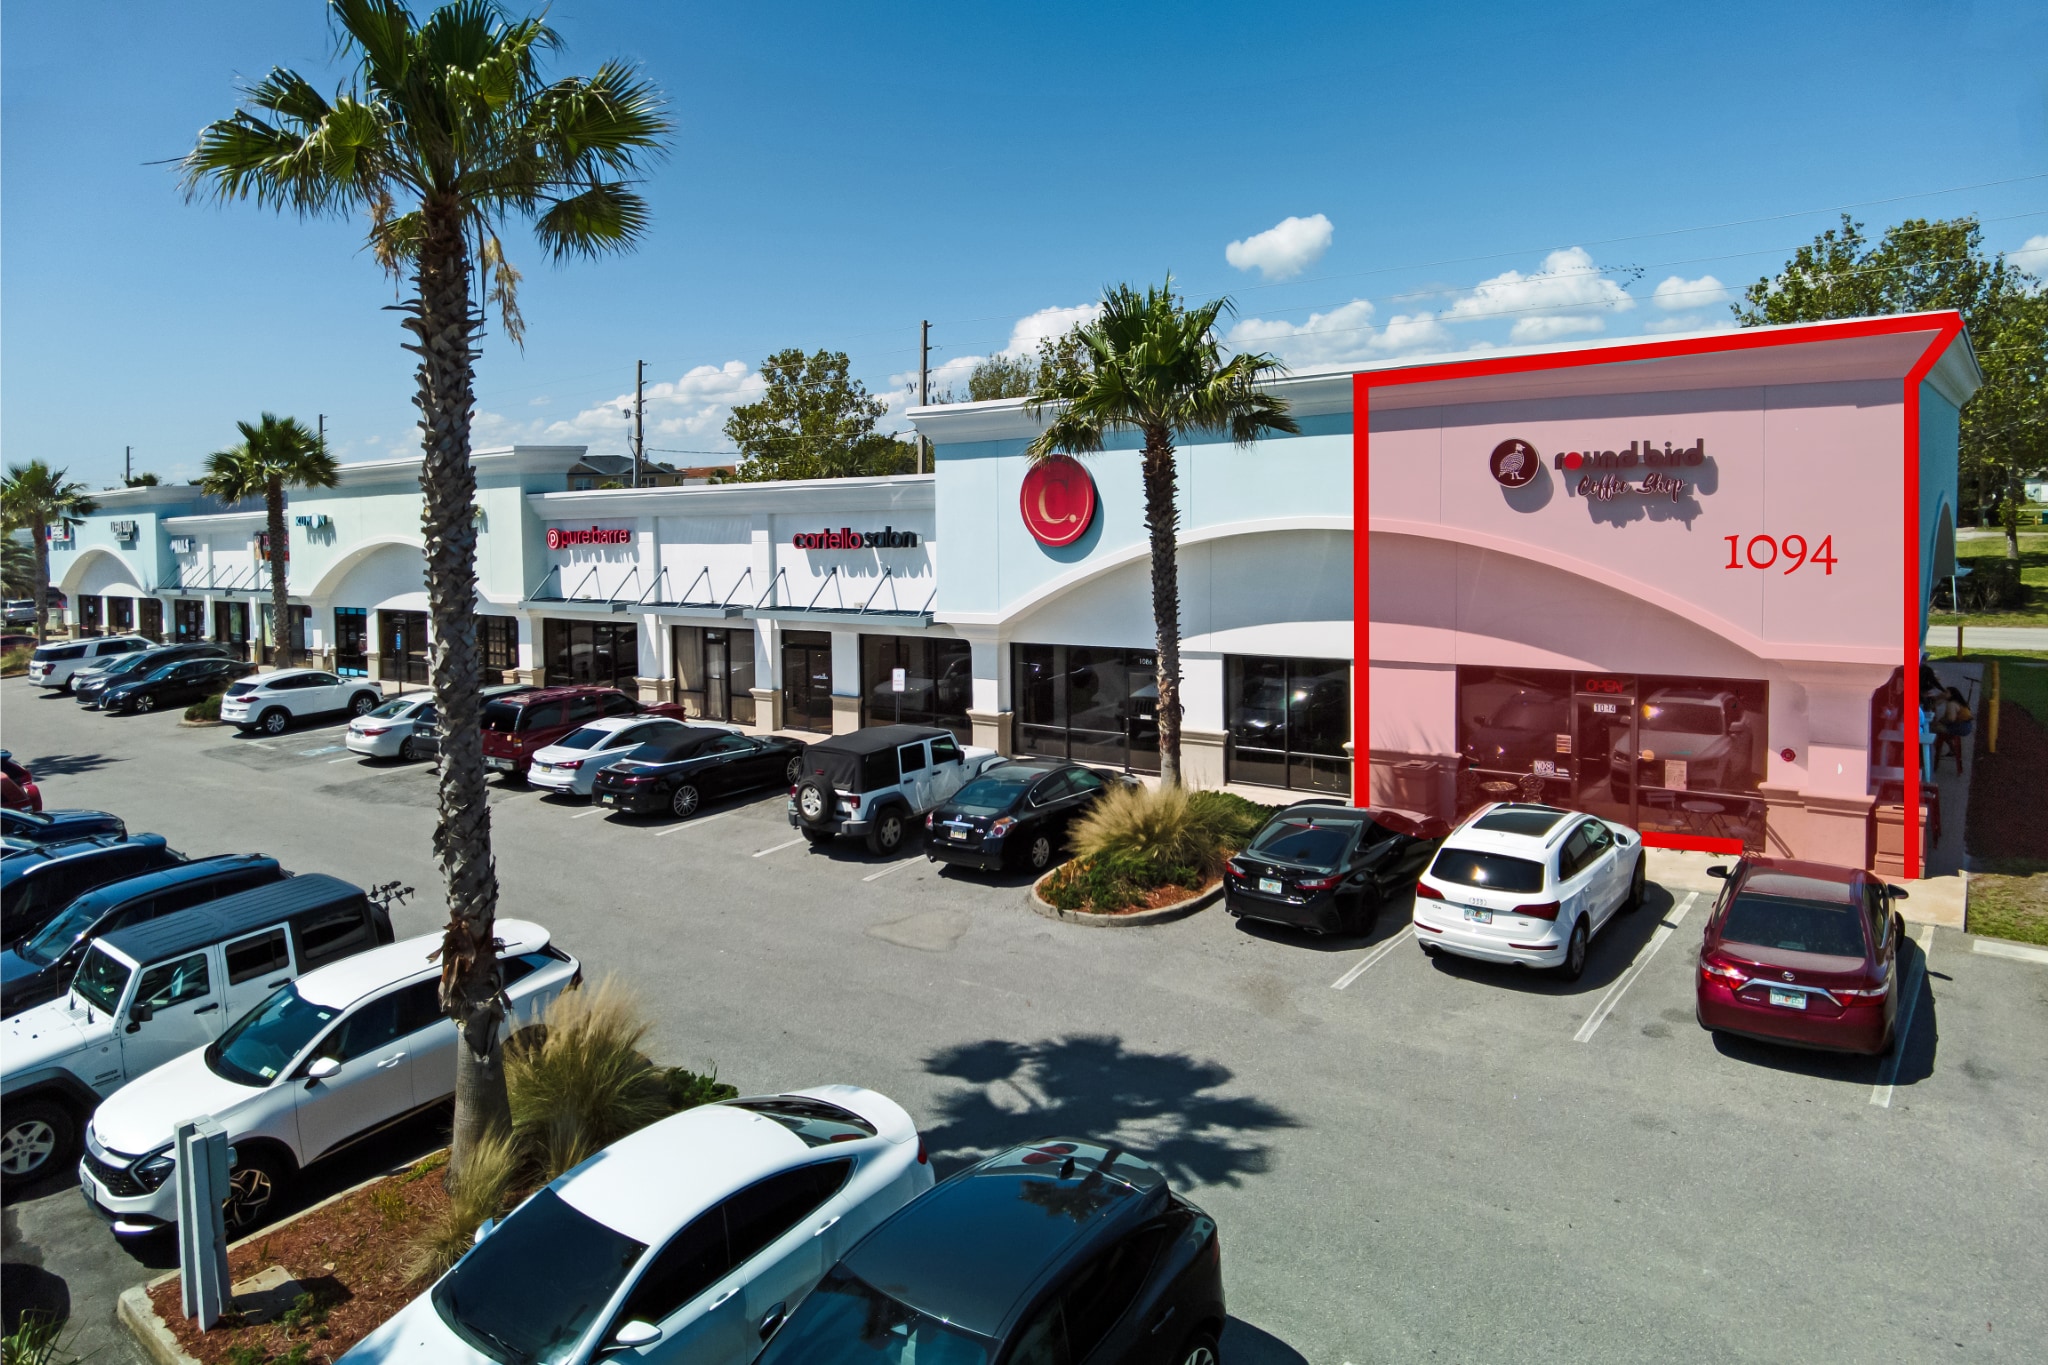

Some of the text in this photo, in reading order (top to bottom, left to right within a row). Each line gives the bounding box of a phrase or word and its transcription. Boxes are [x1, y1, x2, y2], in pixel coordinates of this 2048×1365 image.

[1555, 438, 1704, 470] round bird
[1577, 473, 1688, 503] Coffee Shop
[793, 526, 917, 549] cortello salon
[1585, 679, 1623, 694] OPEN
